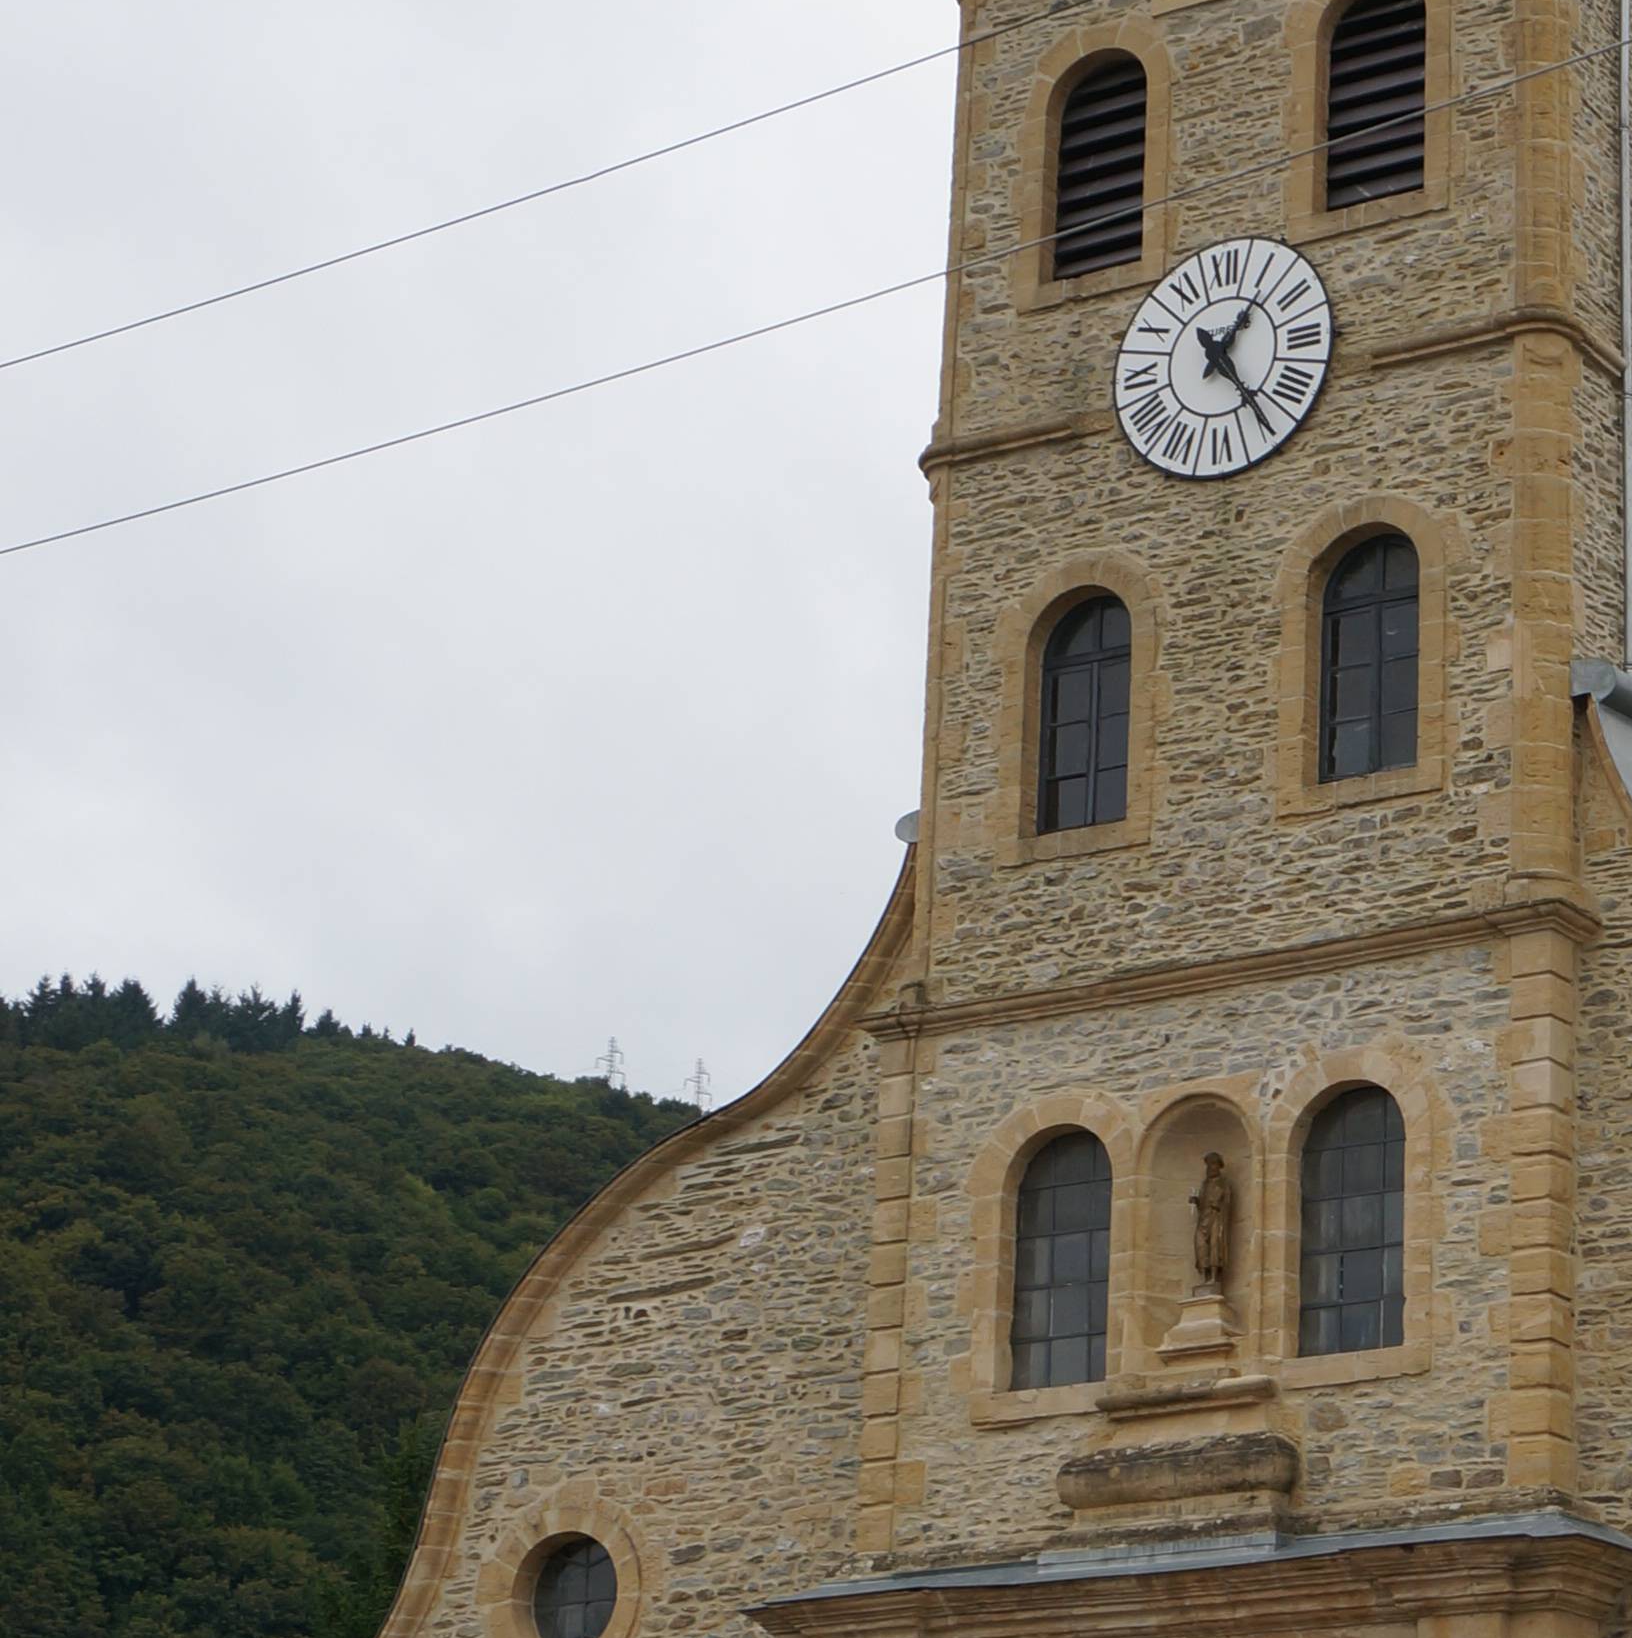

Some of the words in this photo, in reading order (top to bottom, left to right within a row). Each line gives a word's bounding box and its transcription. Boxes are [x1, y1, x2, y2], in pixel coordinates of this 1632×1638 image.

[1210, 248, 1239, 290] XII
[1254, 252, 1275, 288] I
[1169, 271, 1200, 312] XI
[1277, 278, 1311, 312] II
[1137, 318, 1171, 343] X
[1287, 323, 1321, 350] III
[1124, 362, 1158, 391] IX
[1272, 365, 1314, 404] IIII
[1129, 393, 1171, 445] VIII
[1162, 421, 1196, 465] VII
[1212, 425, 1232, 465] VI
